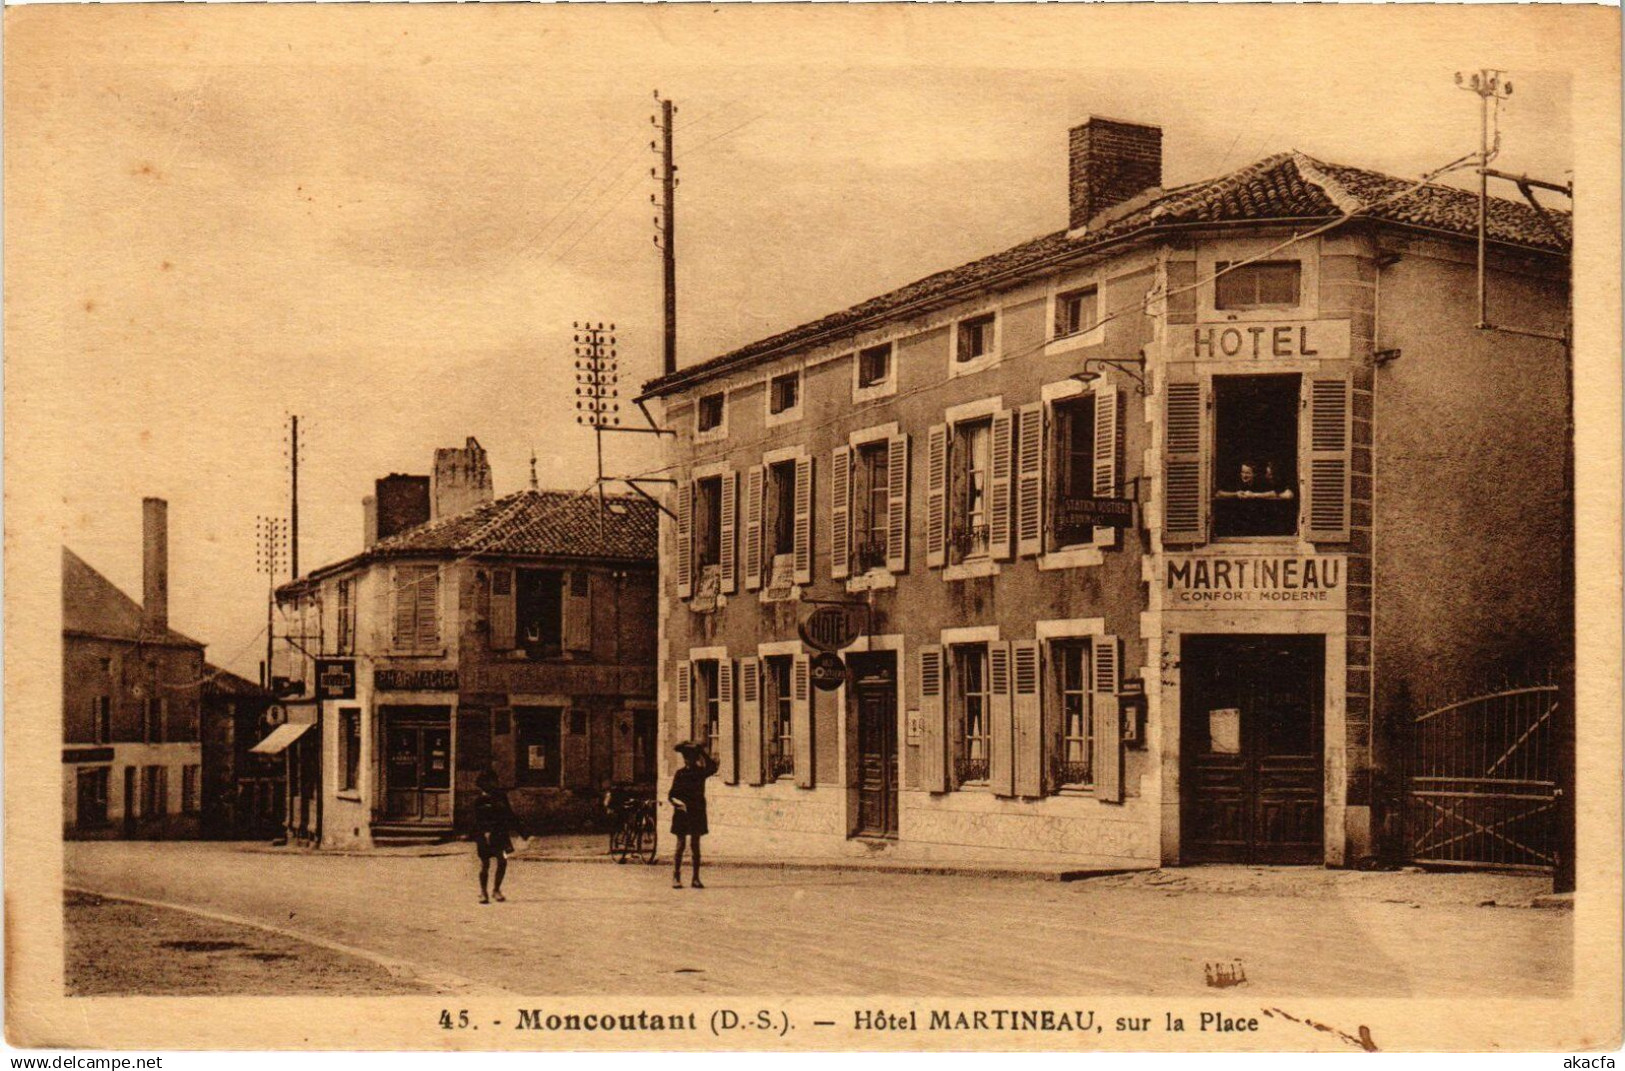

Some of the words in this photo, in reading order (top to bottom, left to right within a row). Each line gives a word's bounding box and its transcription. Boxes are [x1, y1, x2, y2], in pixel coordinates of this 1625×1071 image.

[1167, 559, 1339, 589] MARTINEAU
[1180, 591, 1250, 601] CONFORT
[1259, 591, 1328, 601] MODERNE
